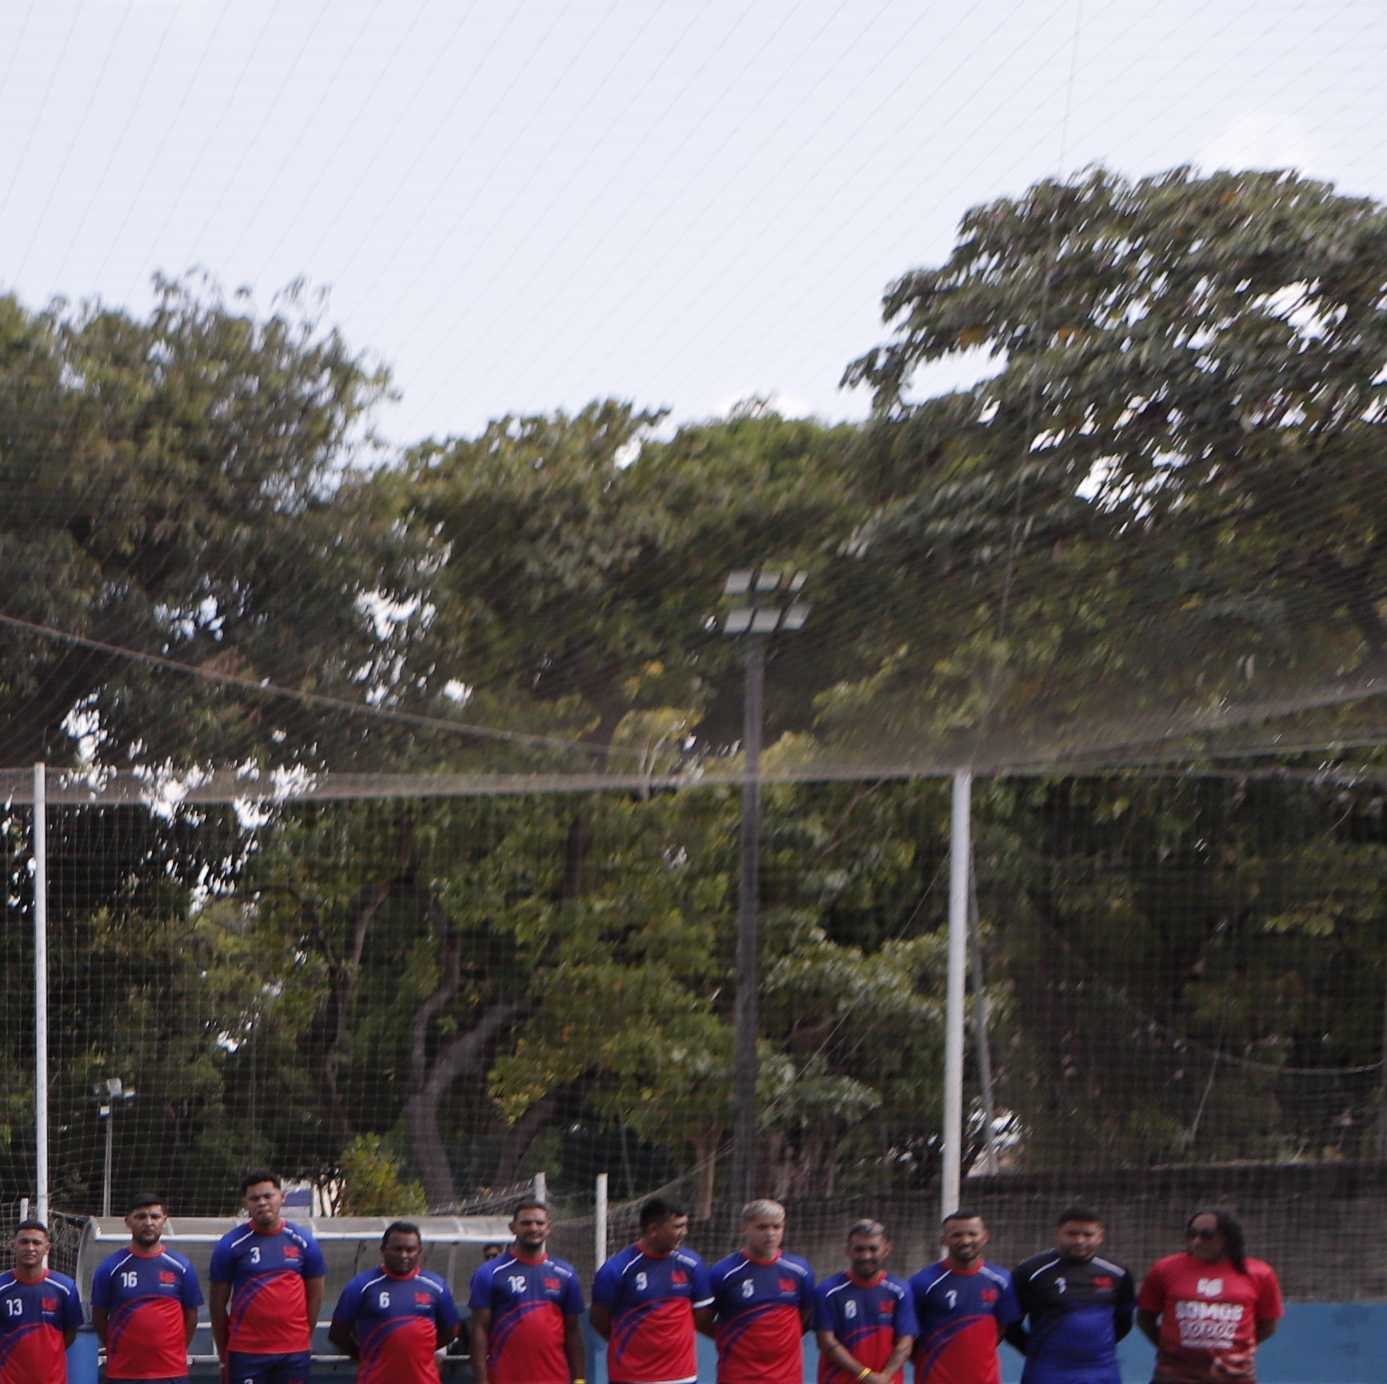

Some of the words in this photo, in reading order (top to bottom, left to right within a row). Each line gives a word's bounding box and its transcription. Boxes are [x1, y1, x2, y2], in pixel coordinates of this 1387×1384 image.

[251, 1246, 260, 1264] 3
[121, 1271, 137, 1288] 16
[507, 1275, 527, 1293] 12
[635, 1271, 648, 1291] 9
[742, 1279, 754, 1298] 5
[6, 1298, 23, 1316] 13
[379, 1292, 390, 1309] 6
